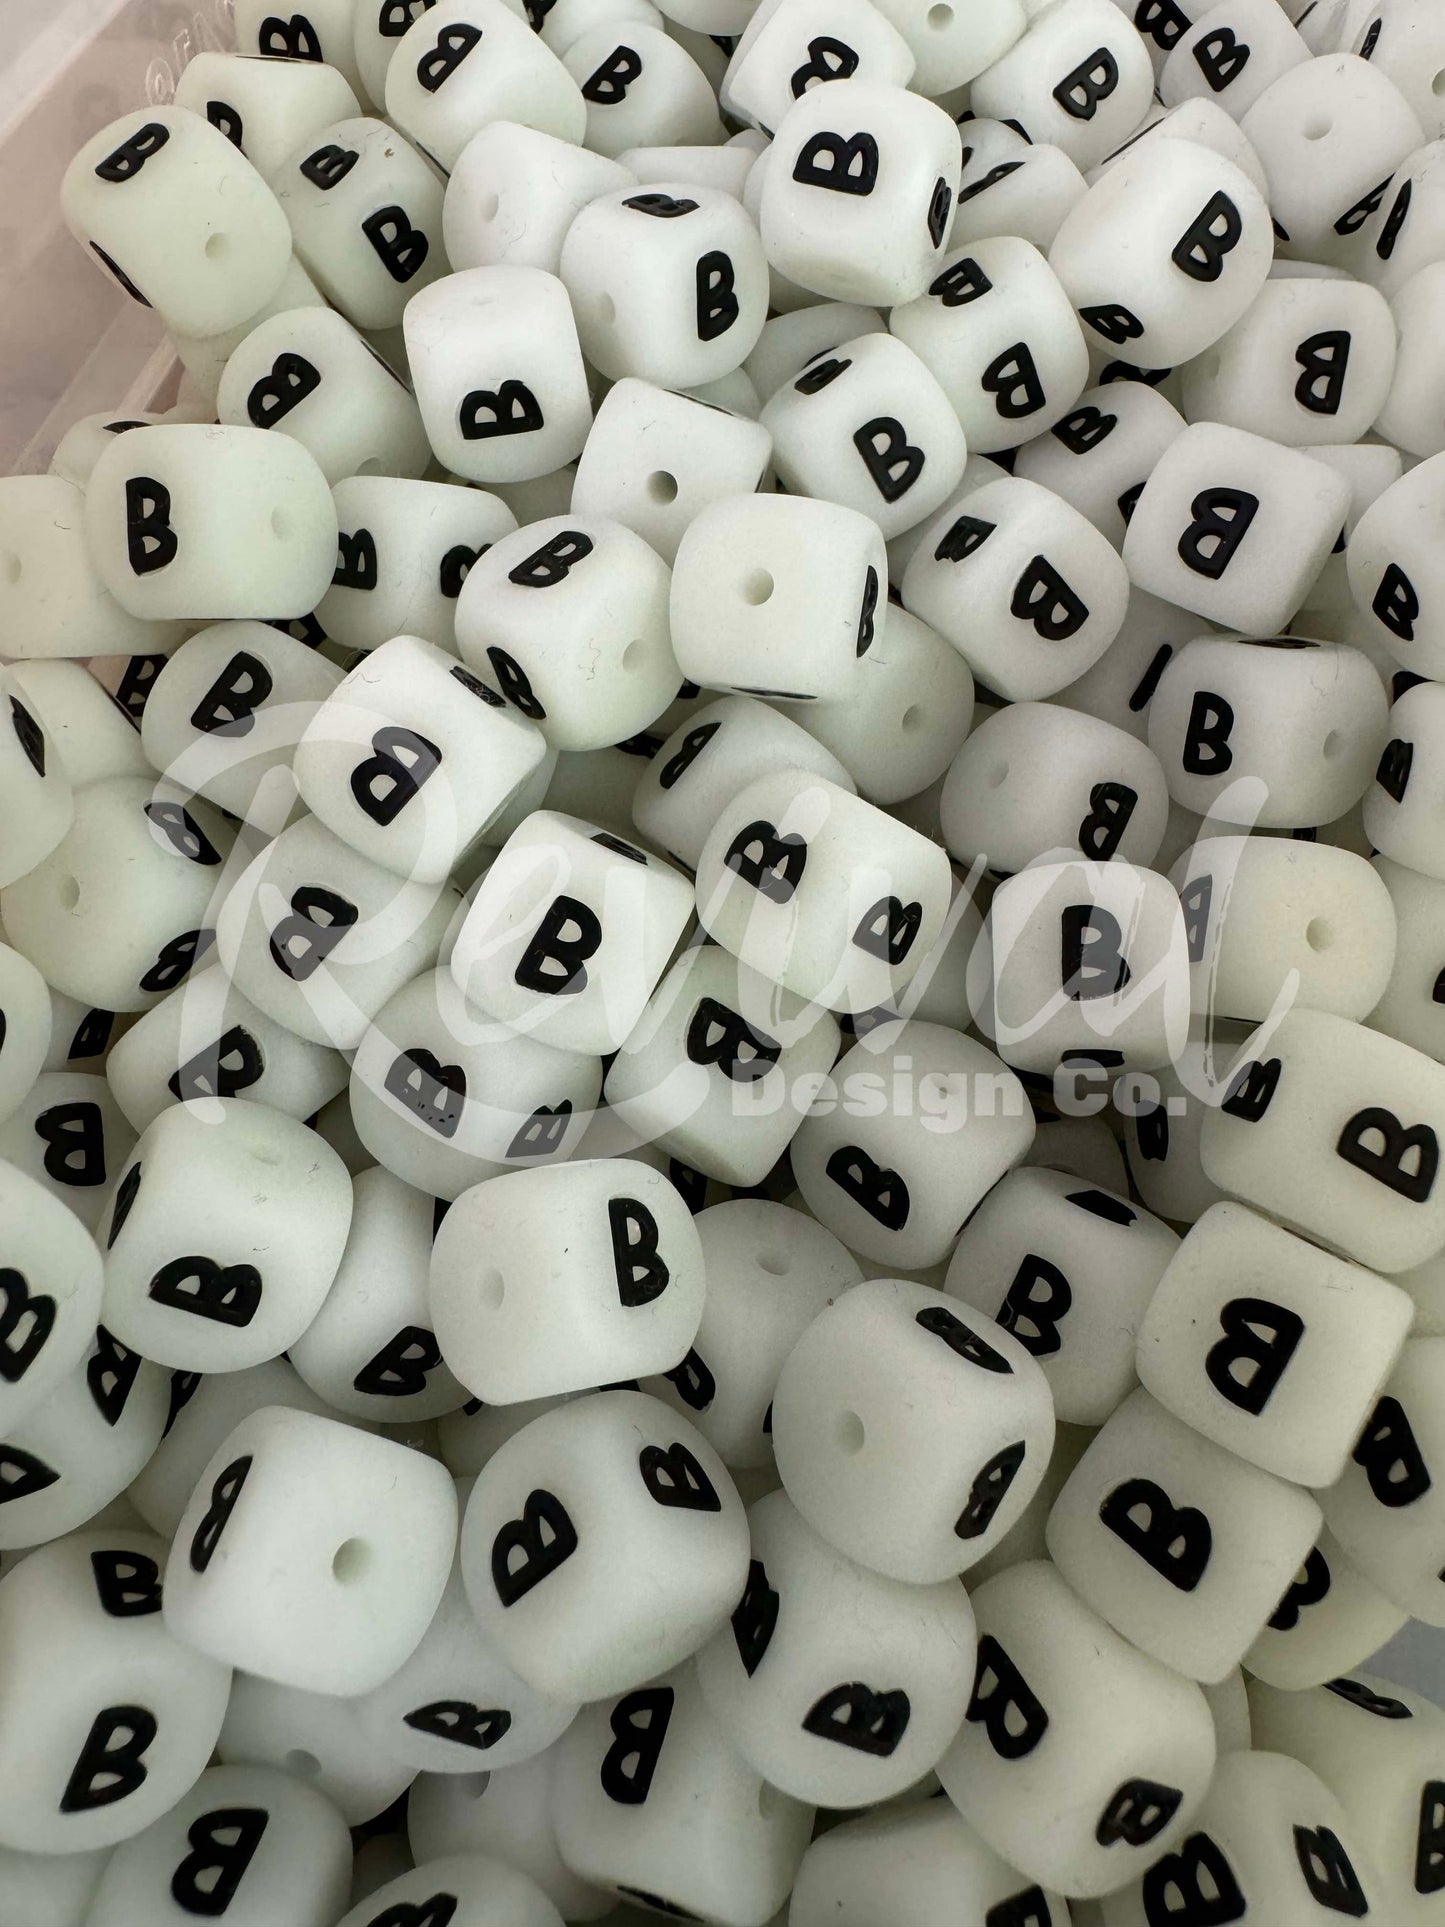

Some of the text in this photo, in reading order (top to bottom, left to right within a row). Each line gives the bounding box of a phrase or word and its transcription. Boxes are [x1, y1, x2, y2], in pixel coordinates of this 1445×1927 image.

[259, 15, 324, 62] B
[417, 24, 482, 93] B
[581, 46, 642, 105] B
[791, 37, 859, 99] B
[1192, 28, 1250, 92] B
[1053, 48, 1118, 121] B
[95, 123, 169, 183] B
[300, 145, 359, 190] B
[793, 132, 878, 196] B
[362, 206, 429, 283] B
[1172, 191, 1242, 282] B
[696, 251, 739, 341] B
[928, 258, 992, 307] B
[1078, 304, 1144, 344] B
[247, 353, 321, 429] B
[460, 380, 544, 440] B
[982, 342, 1046, 419] B
[1295, 331, 1351, 415] B
[853, 417, 925, 504] B
[1052, 406, 1117, 454] B
[126, 477, 177, 576] B
[508, 531, 593, 588] B
[1178, 488, 1259, 580] B
[1010, 555, 1089, 641] B
[1372, 563, 1419, 641] B
[191, 651, 273, 737] B
[1183, 691, 1234, 776] B
[351, 727, 442, 826] B
[144, 802, 221, 866] B
[724, 821, 807, 903] B
[1078, 782, 1138, 861] B
[270, 887, 358, 981] B
[515, 895, 602, 995] B
[852, 896, 922, 965] B
[1062, 905, 1131, 1001] B
[687, 997, 782, 1082] B
[385, 1048, 466, 1137] B
[506, 1099, 572, 1157] B
[1221, 1058, 1281, 1123] B
[35, 1102, 106, 1186] B
[1336, 1107, 1439, 1203] B
[826, 1146, 910, 1231] B
[148, 1256, 262, 1327] B
[608, 1198, 669, 1307] B
[995, 1254, 1072, 1358] B
[354, 1326, 443, 1396] B
[1205, 1298, 1305, 1416] B
[639, 1442, 721, 1512] B
[1352, 1395, 1431, 1507] B
[491, 1489, 578, 1608] B
[1099, 1478, 1212, 1592] B
[91, 1550, 163, 1618] B
[403, 1700, 511, 1750] B
[802, 1682, 911, 1758] B
[966, 1634, 1048, 1760] B
[60, 1704, 158, 1814] B
[601, 1686, 674, 1805] B
[1095, 1778, 1183, 1847] B
[170, 1807, 269, 1918] B
[1142, 1831, 1247, 1927] B
[1293, 1824, 1368, 1918] B
